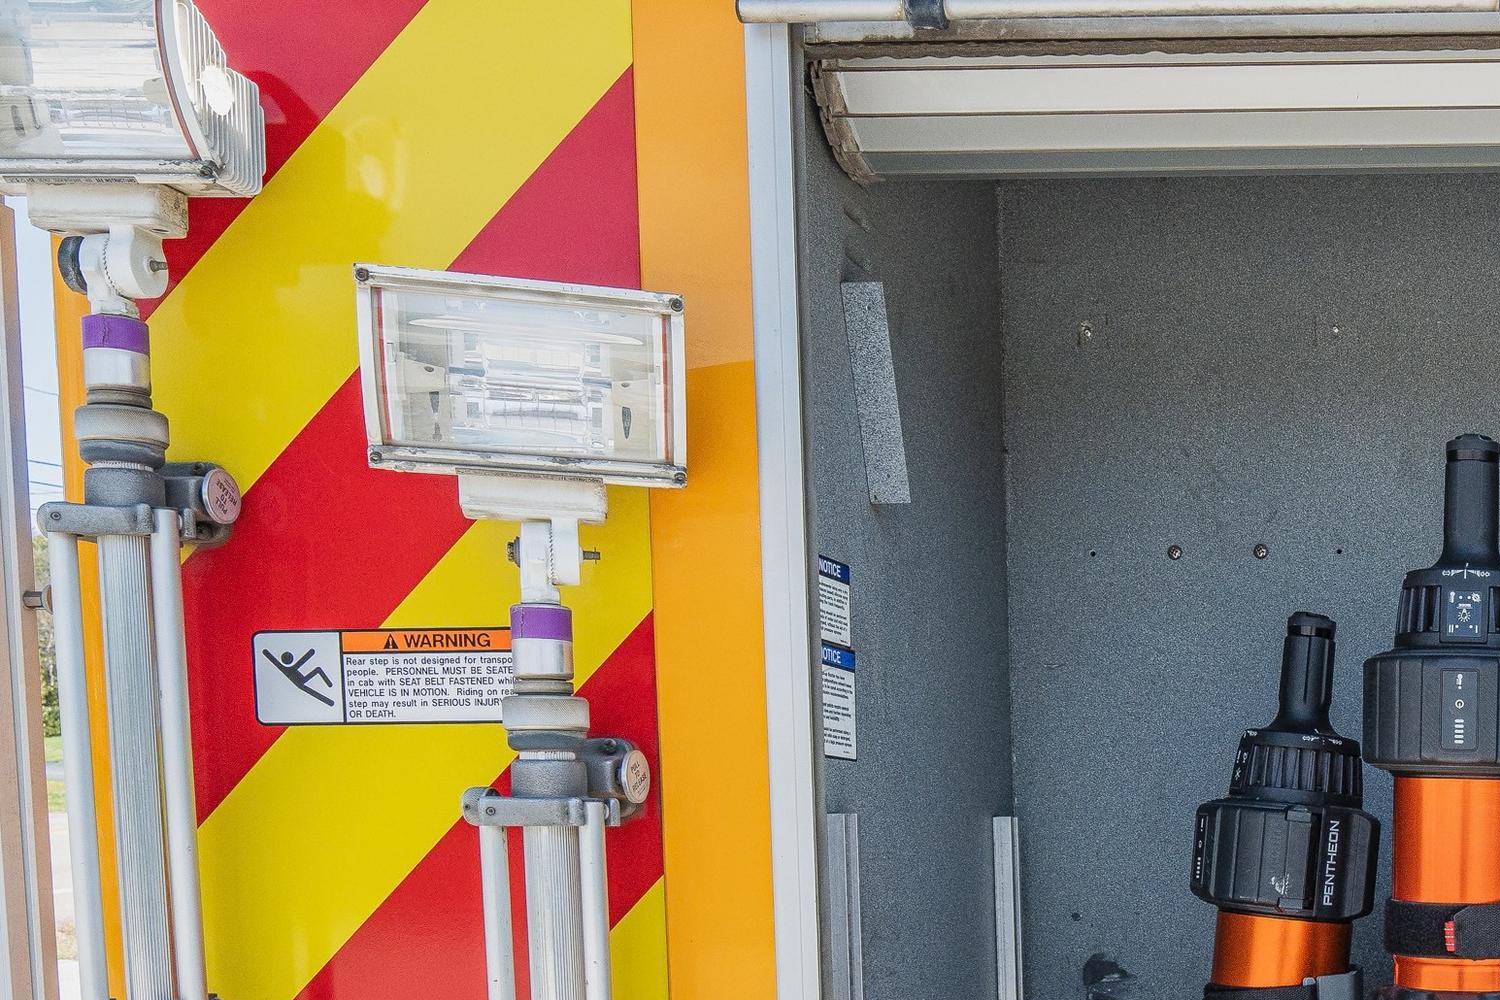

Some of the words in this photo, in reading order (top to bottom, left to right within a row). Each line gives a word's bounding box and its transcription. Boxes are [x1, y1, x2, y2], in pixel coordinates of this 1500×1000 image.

[404, 632, 491, 648] WARNING
[821, 645, 842, 665] OTICE
[346, 657, 366, 666] Rear
[369, 657, 389, 667] step
[392, 656, 400, 665] is
[403, 656, 417, 665] not
[421, 656, 461, 667] designed
[464, 656, 477, 664] for
[480, 656, 513, 666] transpo
[346, 668, 379, 677] people.
[386, 667, 439, 676] PERSONNEL
[442, 667, 467, 675] MUST
[471, 666, 482, 674] BE
[486, 666, 514, 675] SEATE
[347, 679, 355, 687] in
[358, 678, 374, 687] cab
[378, 678, 396, 686] with
[399, 677, 421, 686] SEAT
[425, 677, 445, 685] BELT
[449, 676, 494, 685] FASTENED
[498, 676, 516, 685] whil
[348, 689, 385, 697] VEHICLE
[413, 688, 450, 696] MOTION.
[457, 687, 484, 698] Riding
[501, 688, 515, 696] rea
[349, 699, 368, 709] step
[371, 700, 389, 709] may
[392, 699, 417, 708] result
[421, 698, 429, 707] in
[432, 698, 471, 707] SERIOUS
[349, 709, 362, 718] OR
[366, 709, 397, 718] DEATH.
[1322, 820, 1340, 906] PENTHEON
